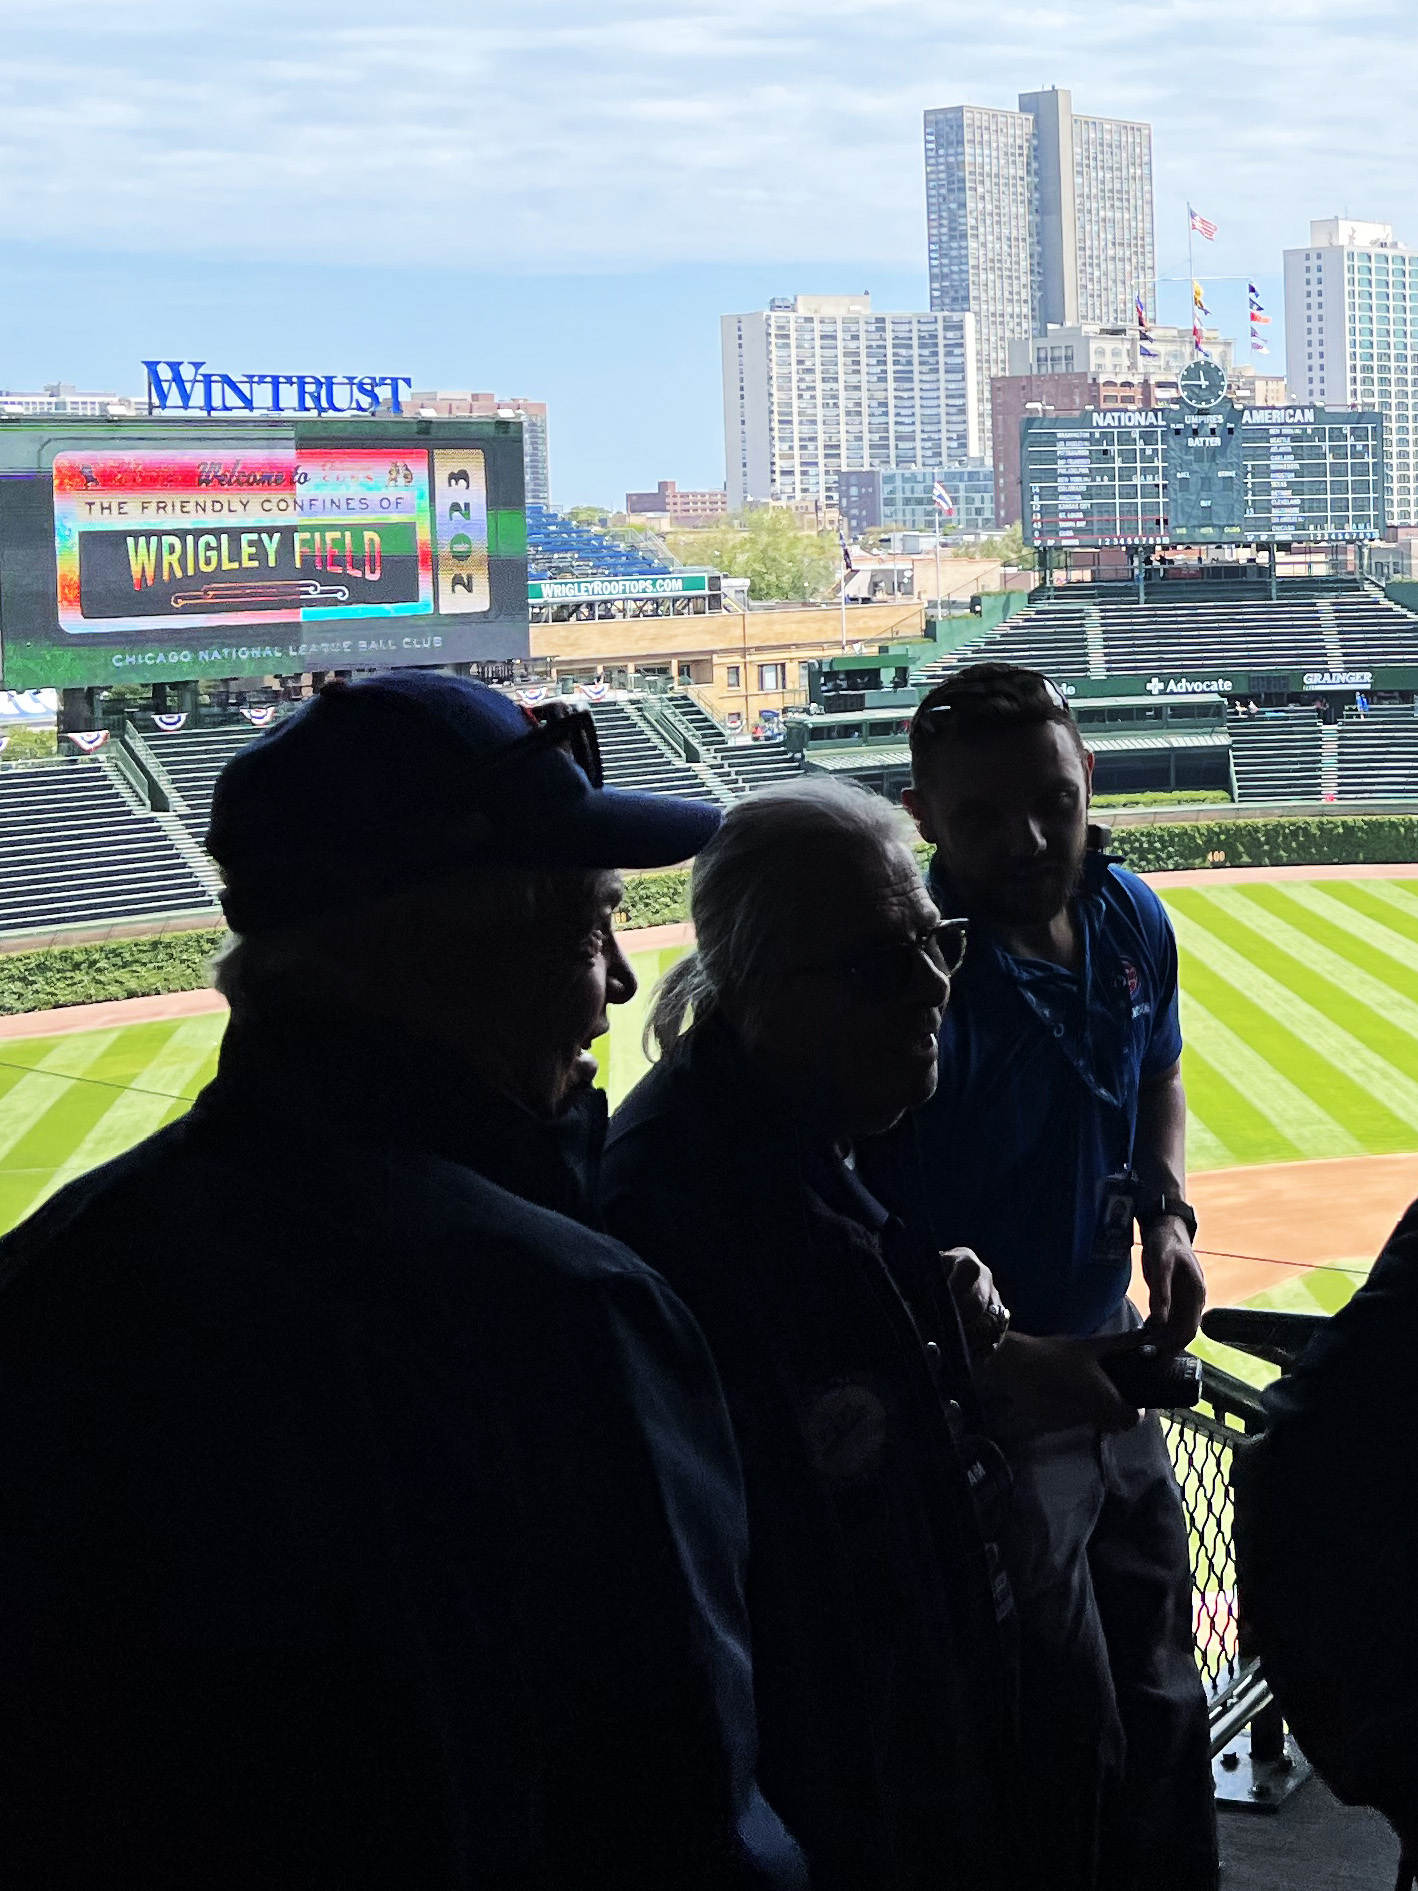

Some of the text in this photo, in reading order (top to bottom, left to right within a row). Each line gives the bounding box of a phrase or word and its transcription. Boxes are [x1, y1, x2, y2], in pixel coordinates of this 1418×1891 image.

[141, 361, 412, 414] WINTRUST
[1092, 411, 1167, 426] NATIONAL
[1185, 414, 1223, 424] UMPIRES
[1242, 409, 1315, 424] AMERICAN
[1188, 437, 1222, 447] BATTER
[290, 464, 310, 486] to
[85, 496, 405, 516] THE FRIENDLY CONFINES OF
[447, 468, 474, 594] 2023
[126, 530, 383, 592] WRIGLEY FIELD
[541, 578, 683, 599] WRIGLEYROOFTOPS.COM
[112, 636, 443, 667] CHICAGO NATIONAL LEAGUE BALL CLUB
[1166, 677, 1232, 694] Advocate
[1302, 671, 1373, 685] GRAINGER
